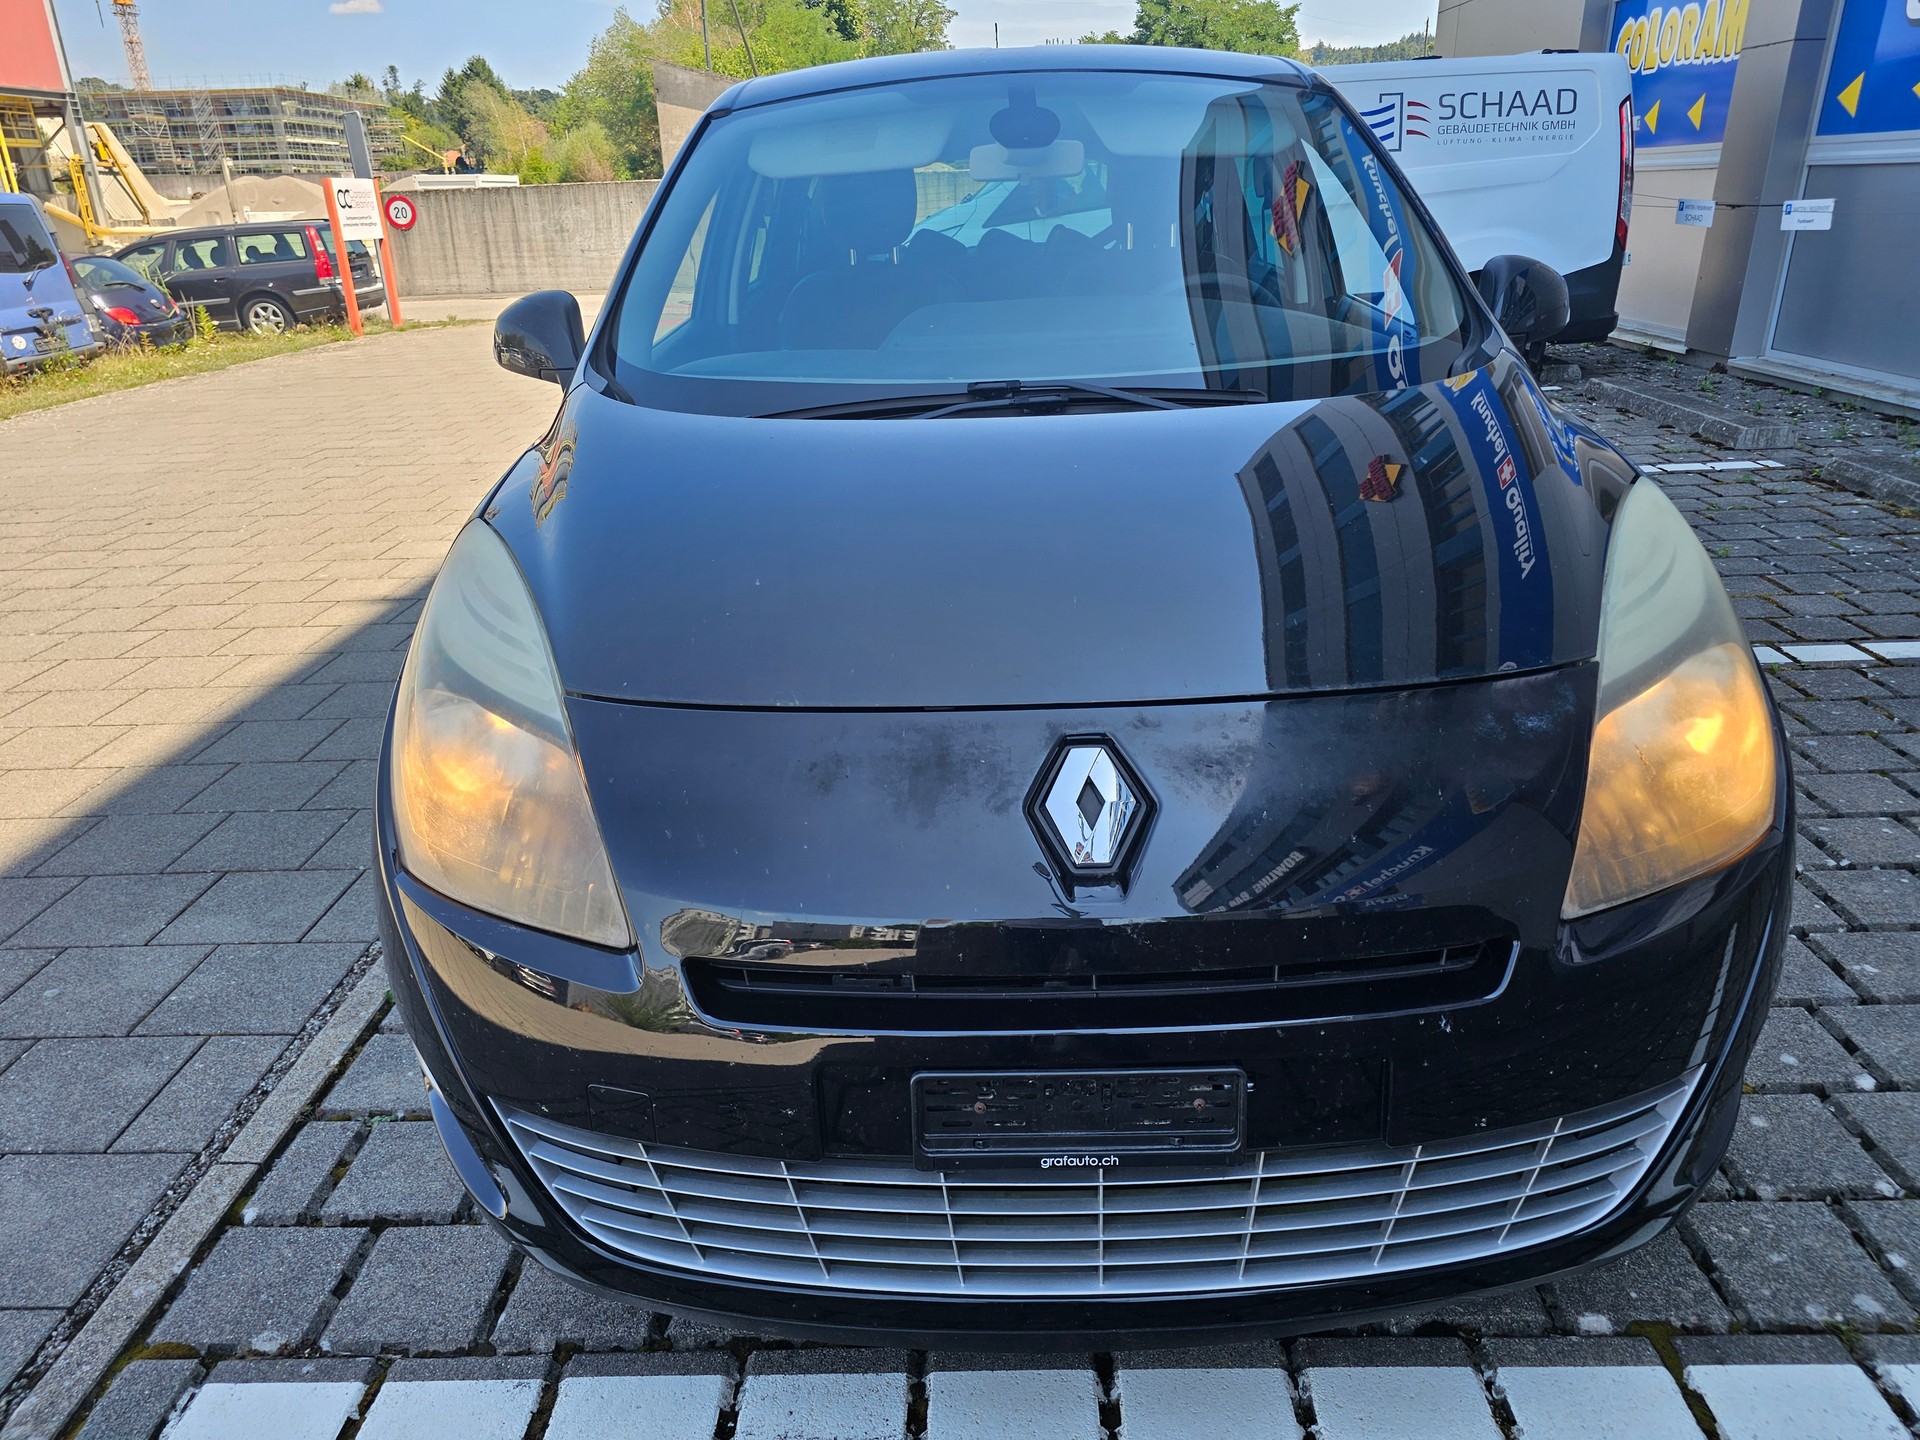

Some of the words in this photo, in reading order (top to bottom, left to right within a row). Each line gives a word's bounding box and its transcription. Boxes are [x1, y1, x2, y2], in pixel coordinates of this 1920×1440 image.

[1438, 88, 1578, 121] SCHAAD
[1437, 120, 1539, 135] GEBÄUDETECHNIK
[1541, 119, 1576, 131] GMBH
[1436, 137, 1483, 146] LÜFTUNG
[1531, 133, 1574, 142] ENERGIE
[393, 206, 408, 219] 20
[1040, 1154, 1119, 1169] grafauto.ch
